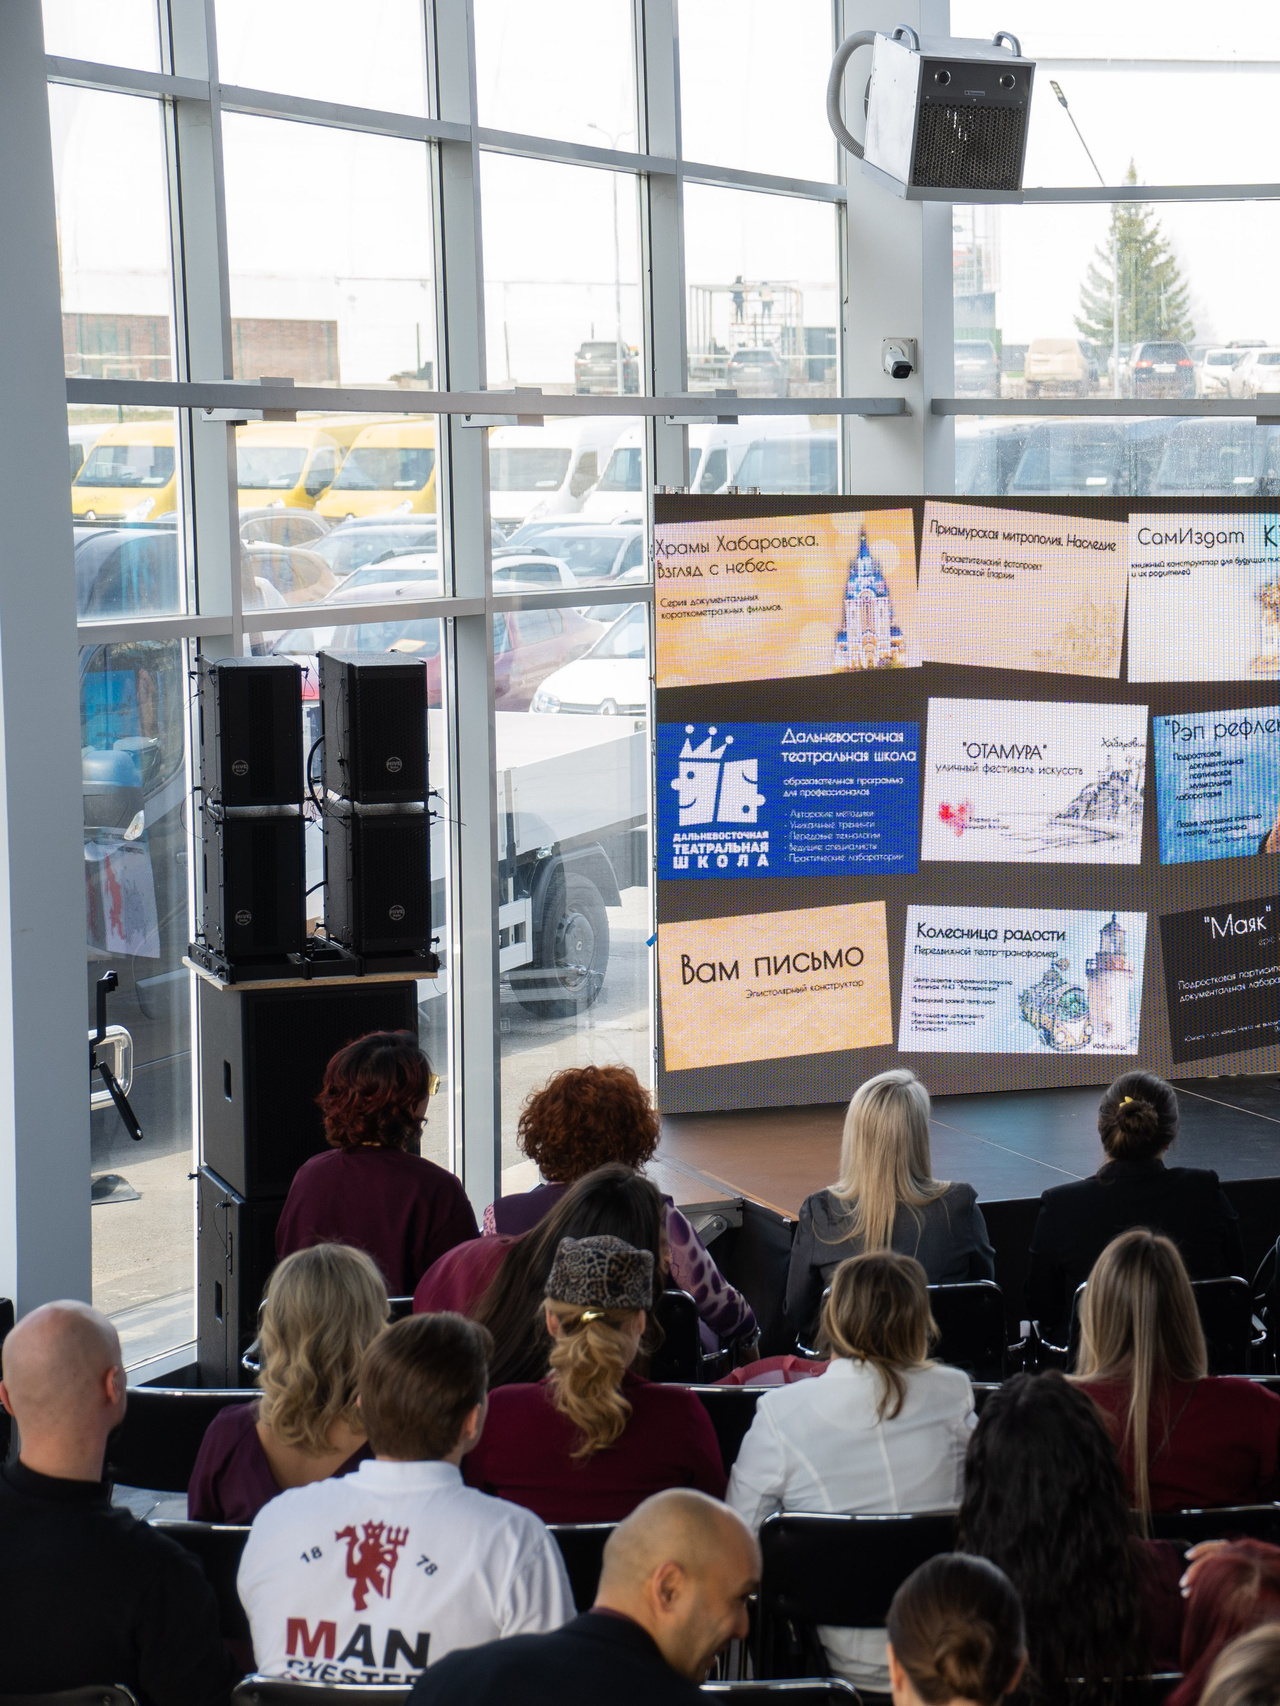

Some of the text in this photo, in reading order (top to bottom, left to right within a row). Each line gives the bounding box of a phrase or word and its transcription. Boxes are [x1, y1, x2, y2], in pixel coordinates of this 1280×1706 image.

[930, 520, 999, 540] Приамурская
[1067, 533, 1116, 551] Наследие
[1137, 527, 1244, 549] СамИздат
[655, 533, 819, 558] Храмы Хабаровска.
[709, 565, 719, 575] с
[1167, 559, 1219, 569] конструктор
[660, 593, 759, 608] Серия документальных
[661, 607, 743, 620] короткометражных
[781, 728, 904, 745] Дальневосточная
[782, 751, 917, 765] театральная школа
[935, 763, 1083, 776] уличный фестиваль искусств
[673, 831, 769, 842] ДАЛЬНЕВОСТОЧНАЯ
[673, 842, 769, 854] ТЕАТРАЛЬНАЯ
[673, 855, 769, 869] ШКОЛА
[917, 922, 1066, 943] Колесница радости
[914, 945, 971, 956] Передвижной
[681, 946, 864, 985] Вам письмо
[810, 979, 864, 992] конструктор
[1178, 973, 1236, 991] Подростковая
[1179, 984, 1246, 1003] документальная
[300, 1546, 439, 1576] 18 78
[285, 1617, 431, 1669] MAN
